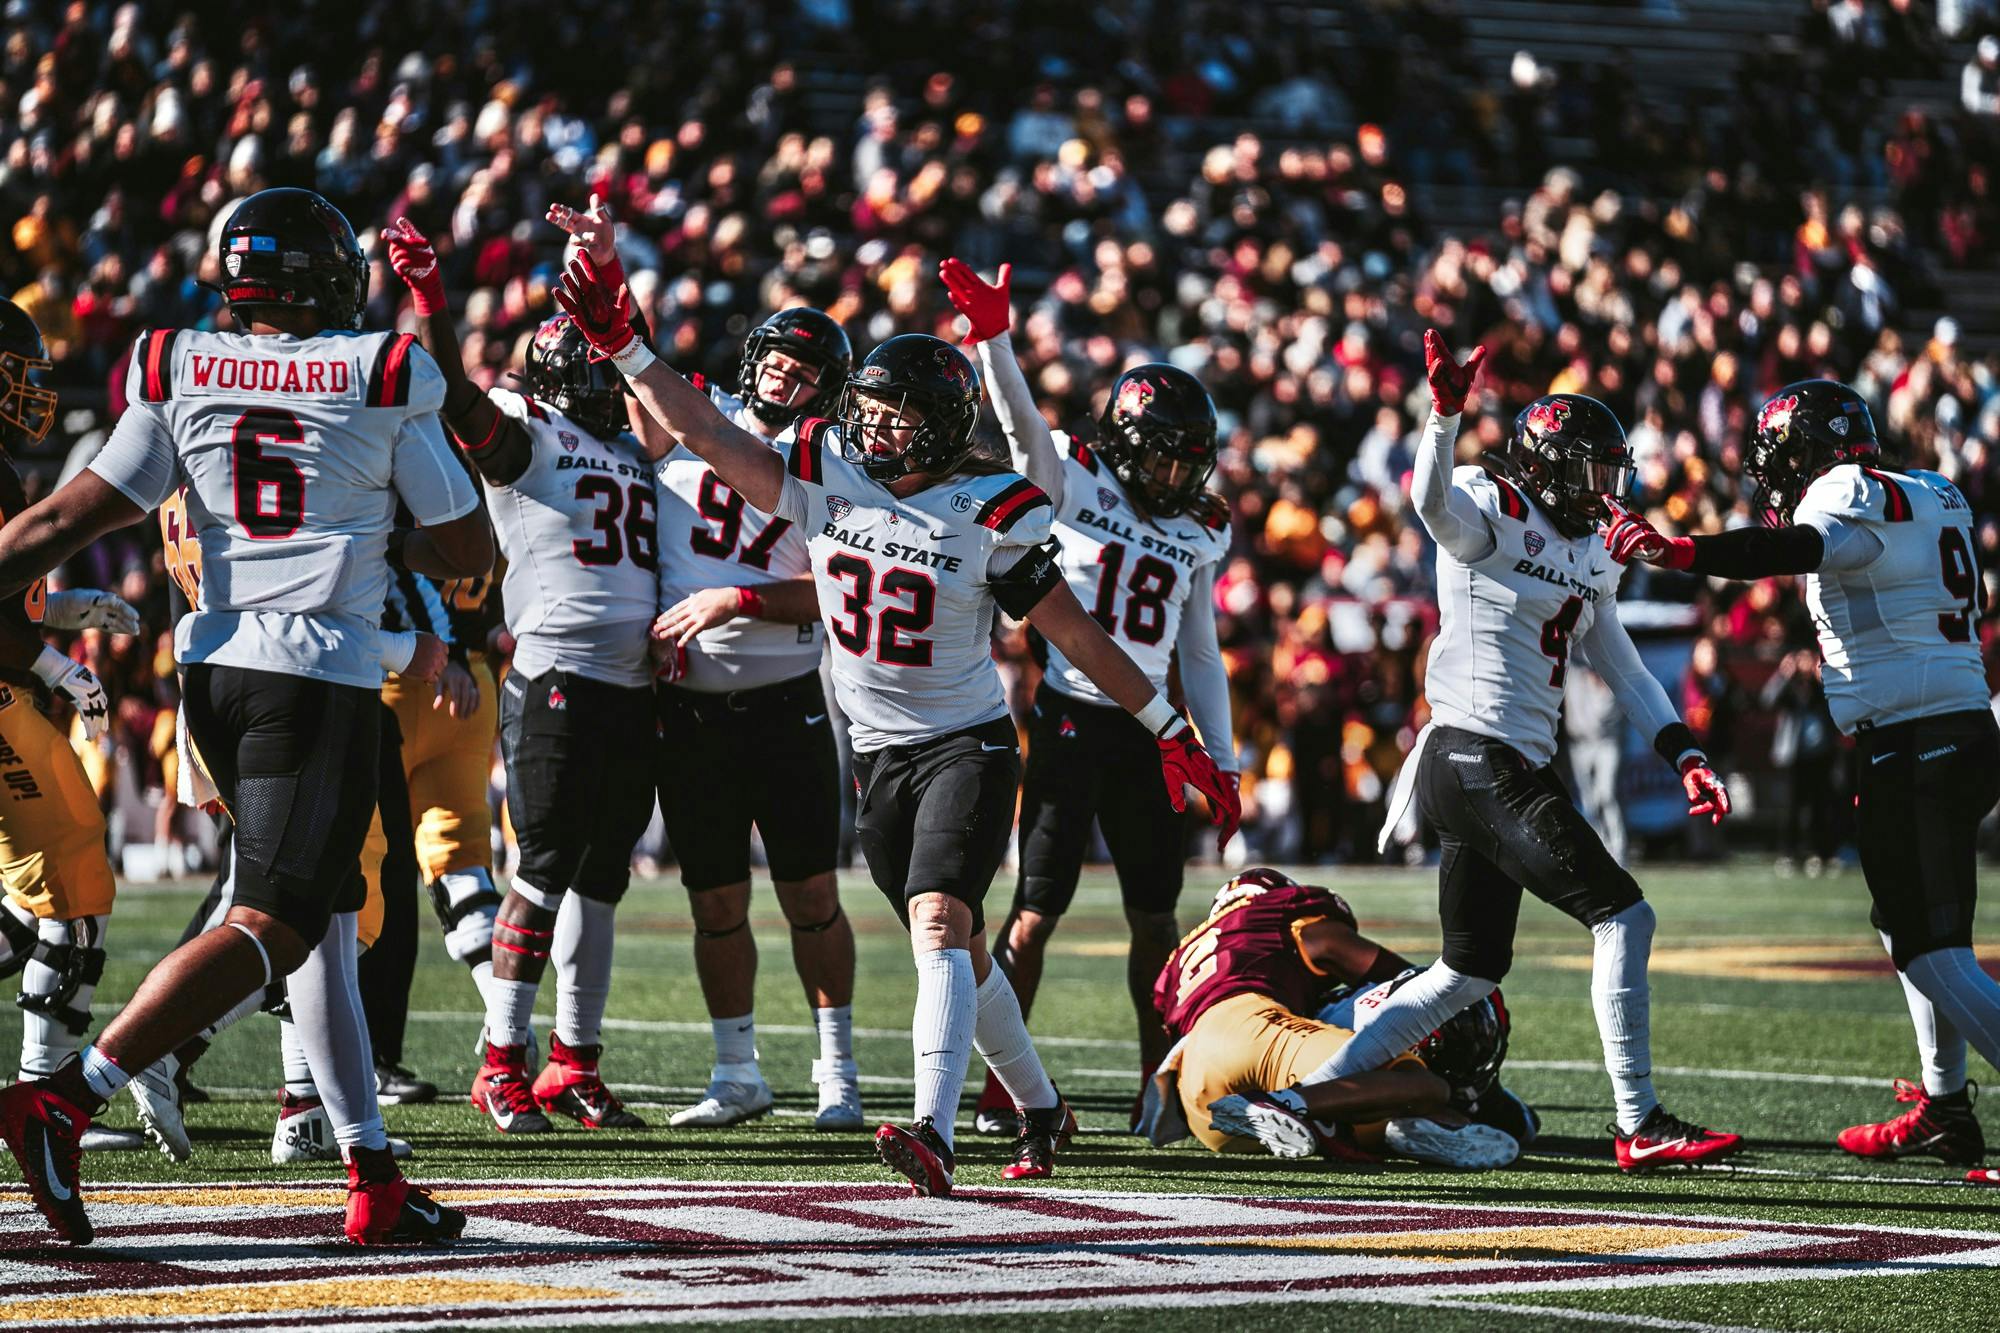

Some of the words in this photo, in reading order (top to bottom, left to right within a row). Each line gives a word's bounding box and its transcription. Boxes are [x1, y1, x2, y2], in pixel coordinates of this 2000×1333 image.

[192, 355, 348, 393] WOODARD
[231, 408, 305, 540] 6
[556, 455, 613, 473] BALL
[572, 474, 659, 573] 36
[690, 468, 794, 572] 97
[953, 495, 970, 510] TC
[822, 522, 876, 553] BALL
[881, 542, 963, 573] STATE
[1075, 508, 1135, 542] BALL
[1140, 535, 1197, 569] STATE
[1088, 540, 1178, 647] 18
[1513, 559, 1569, 587] BALL
[826, 550, 937, 668] 32
[1540, 594, 1584, 689] 4
[3, 769, 43, 801] UP!
